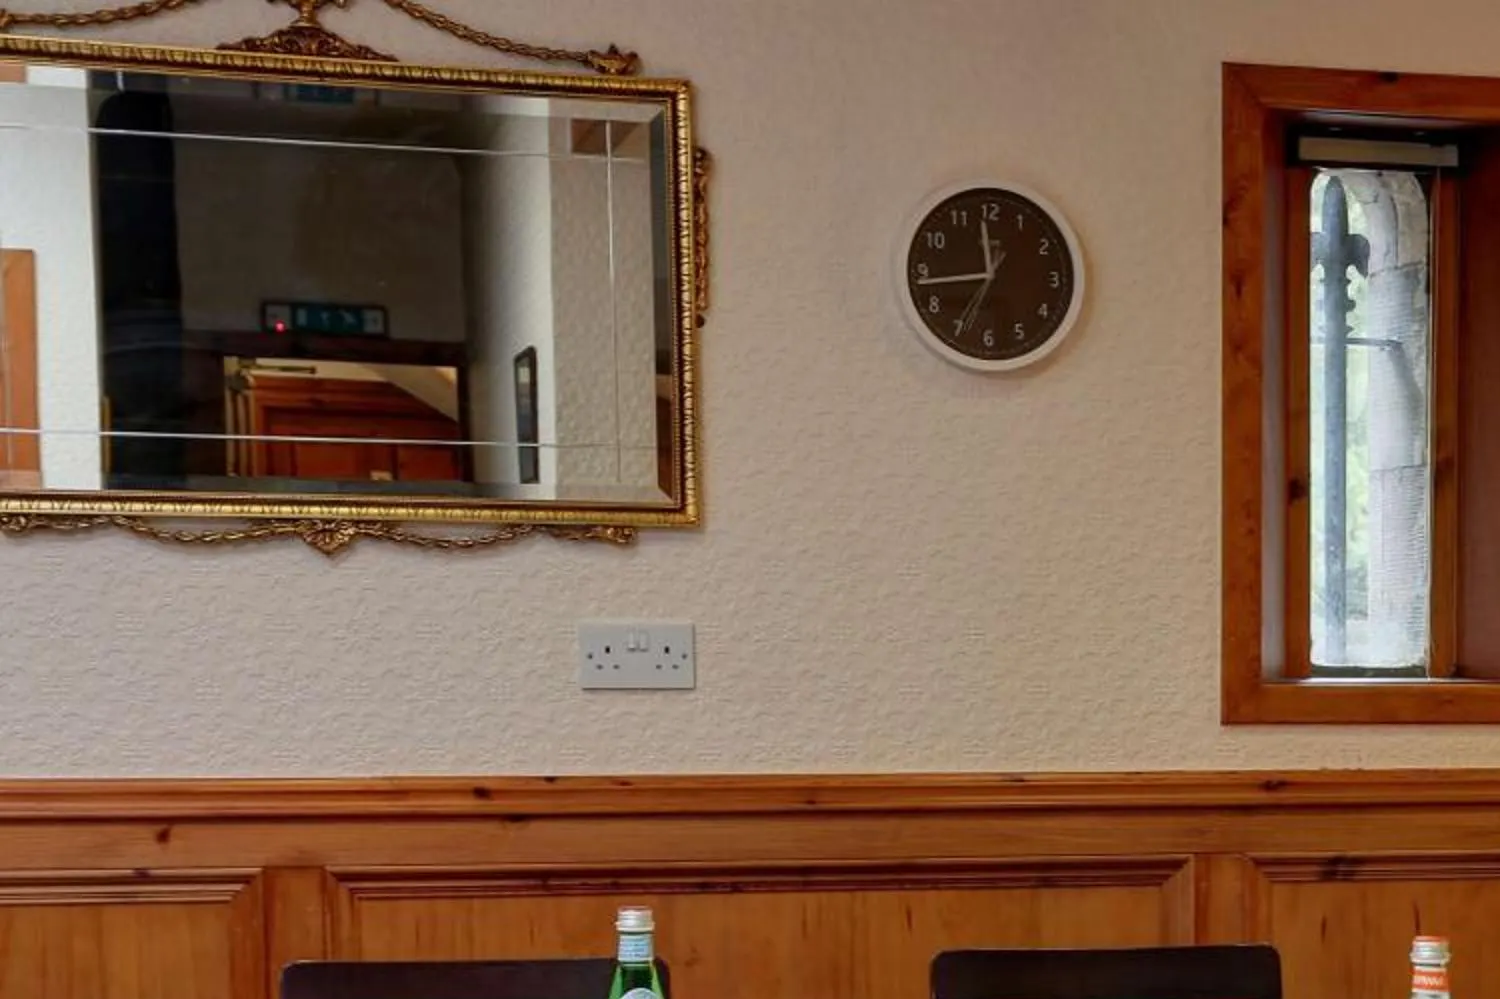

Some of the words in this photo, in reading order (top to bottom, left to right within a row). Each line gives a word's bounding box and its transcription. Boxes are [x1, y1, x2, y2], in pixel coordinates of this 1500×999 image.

[952, 211, 968, 226] 11
[981, 203, 1000, 221] 12
[1016, 213, 1024, 231] 1
[926, 231, 945, 249] 10
[1039, 238, 1049, 255] 2
[917, 263, 929, 279] 9
[1050, 272, 1059, 288] 3
[929, 296, 939, 313] 8
[1038, 304, 1048, 318] 4
[953, 319, 963, 337] 7
[1015, 324, 1025, 340] 5
[984, 331, 993, 347] 6
